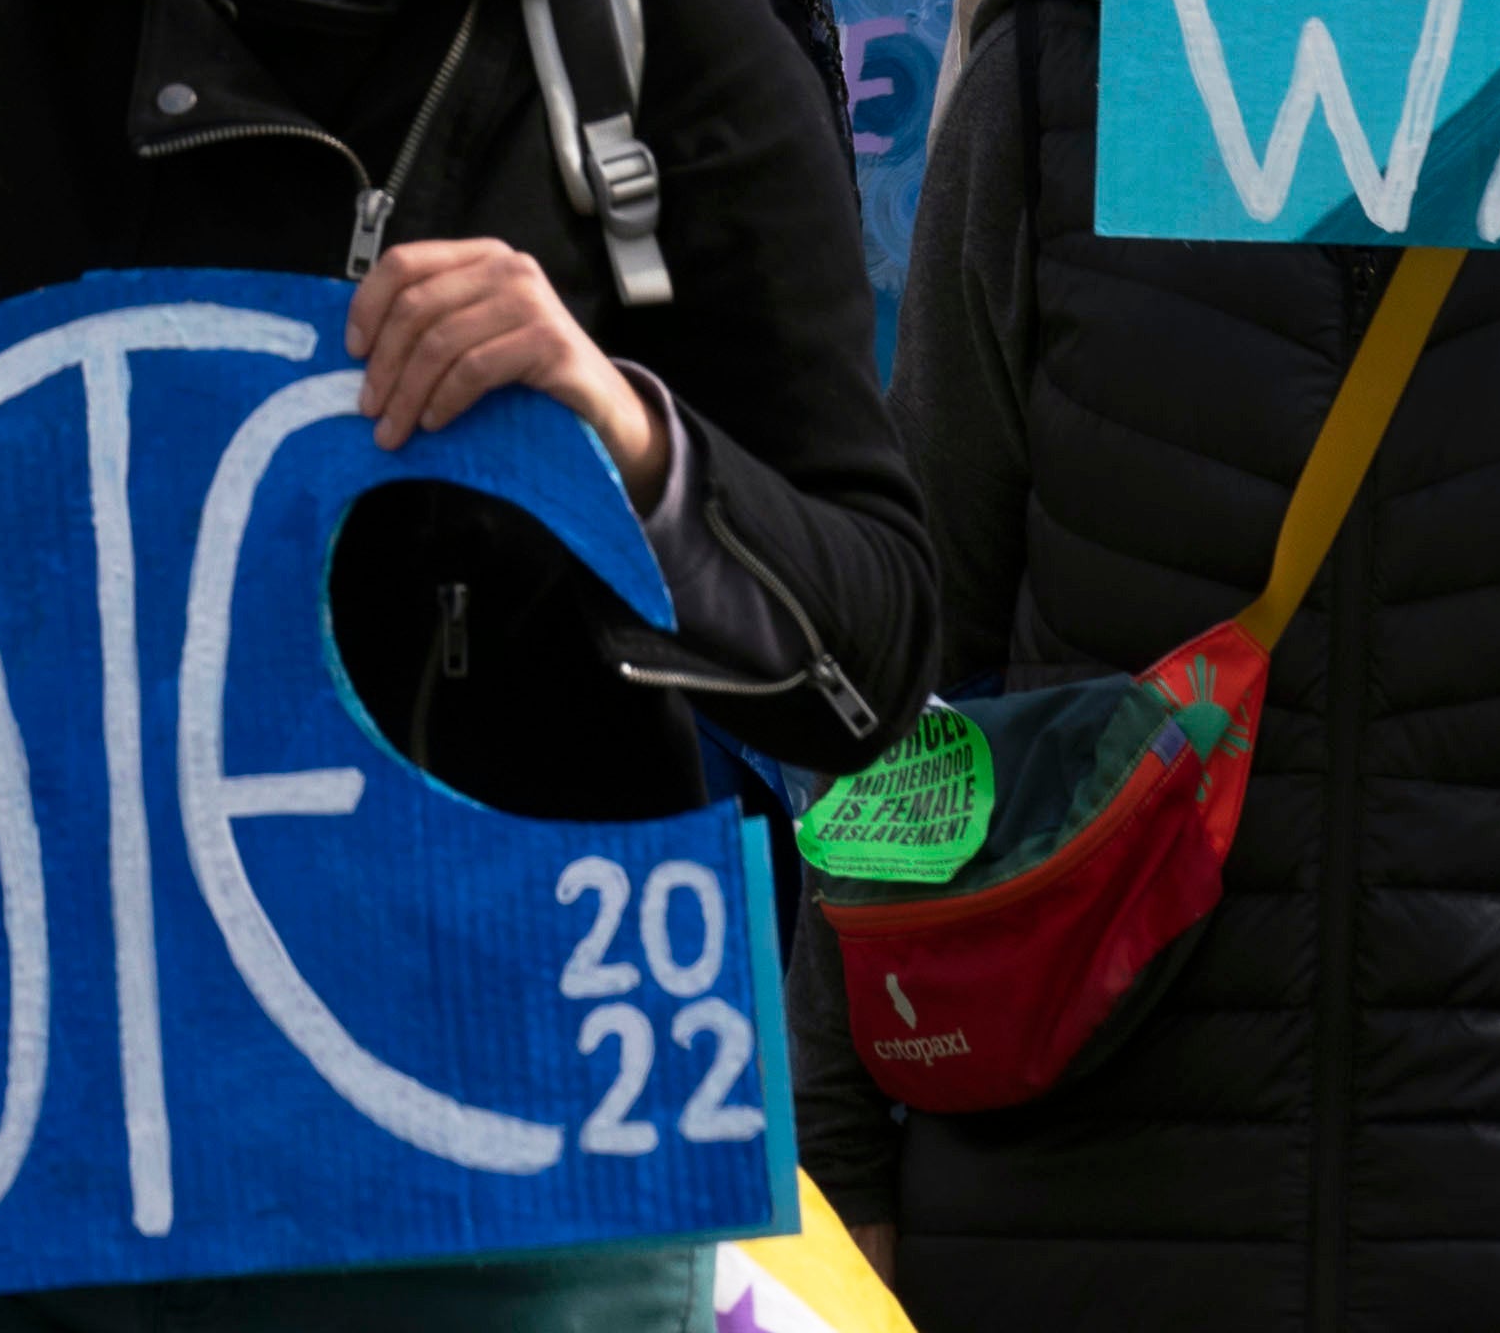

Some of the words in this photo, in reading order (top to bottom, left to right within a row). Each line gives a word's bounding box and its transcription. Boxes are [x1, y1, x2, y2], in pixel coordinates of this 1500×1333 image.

[848, 744, 975, 796] MOTHERHOOD
[831, 798, 868, 822] IS
[871, 775, 977, 824] FEMALE
[815, 815, 972, 847] ENSLAVEMENT
[556, 855, 727, 1000] 20
[873, 1028, 972, 1067] cotopaxi
[577, 1000, 767, 1157] 22
